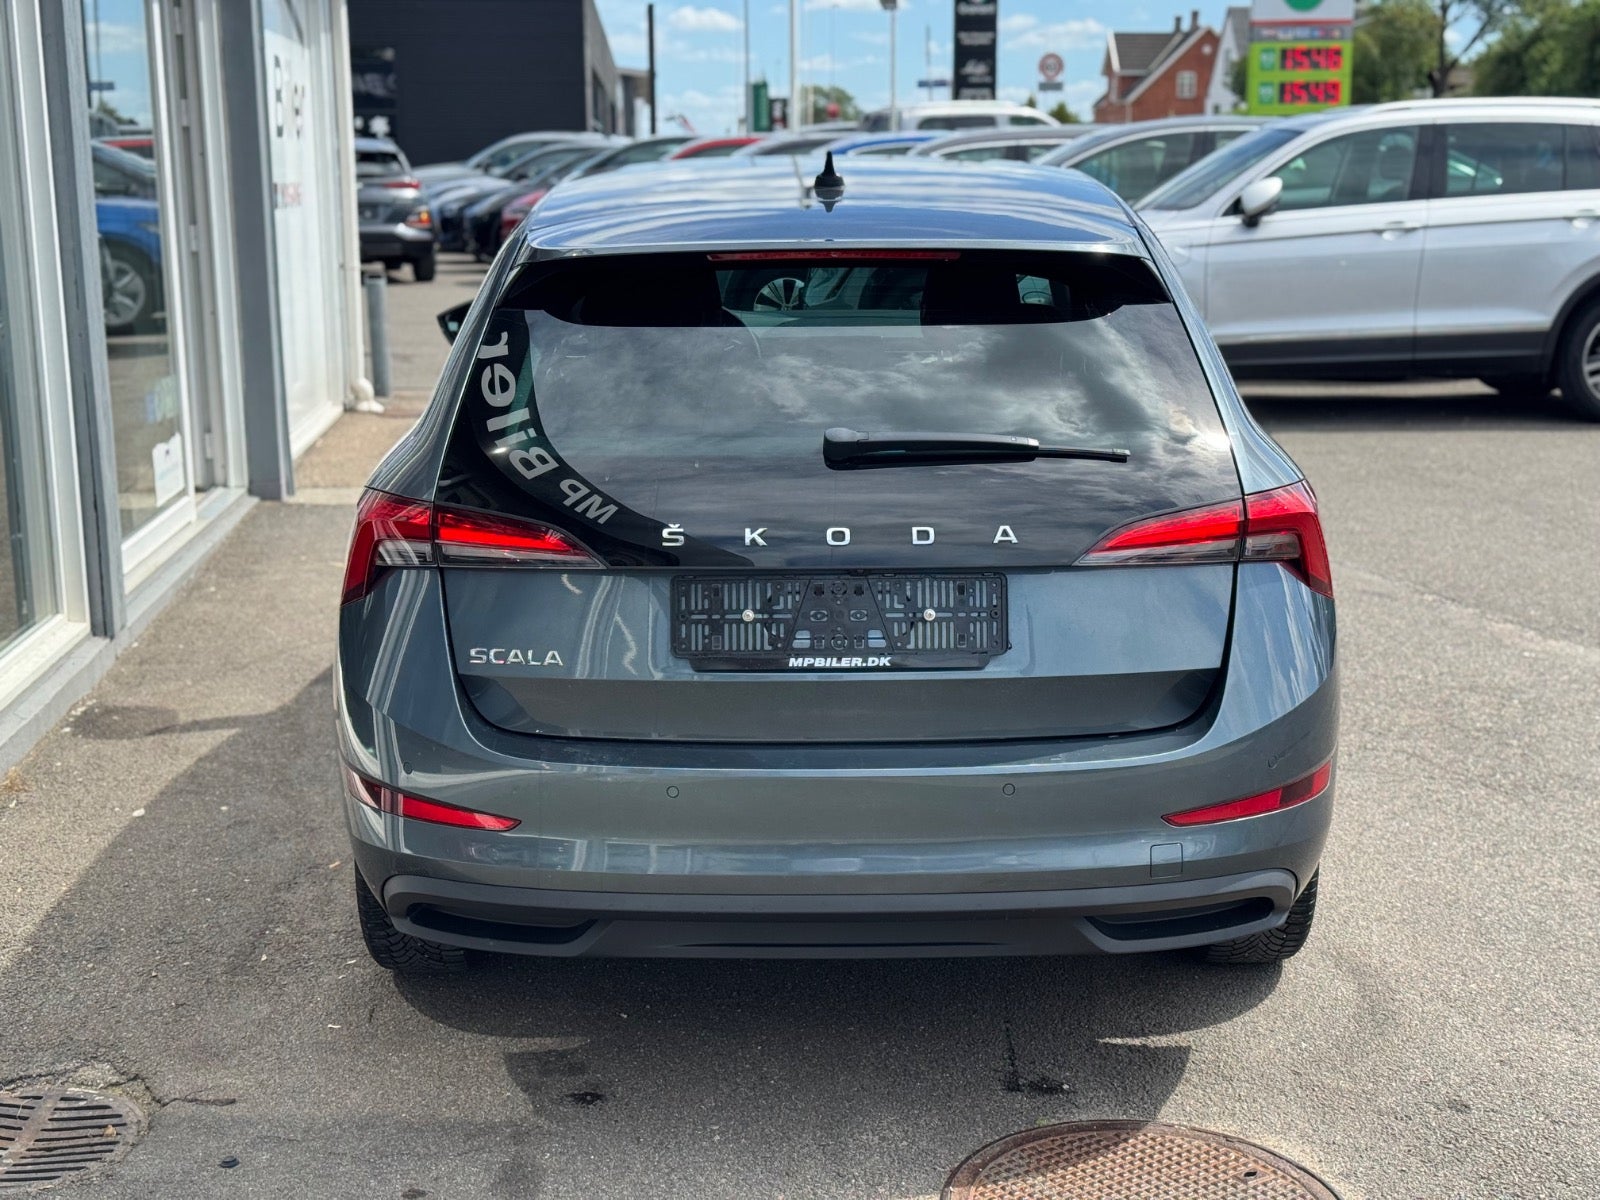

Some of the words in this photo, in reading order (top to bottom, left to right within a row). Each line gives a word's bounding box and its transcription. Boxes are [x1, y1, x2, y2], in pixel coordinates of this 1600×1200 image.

[661, 523, 1019, 547] ŠKODA
[469, 647, 564, 666] SCALA
[788, 656, 892, 669] MPBILER.DK
